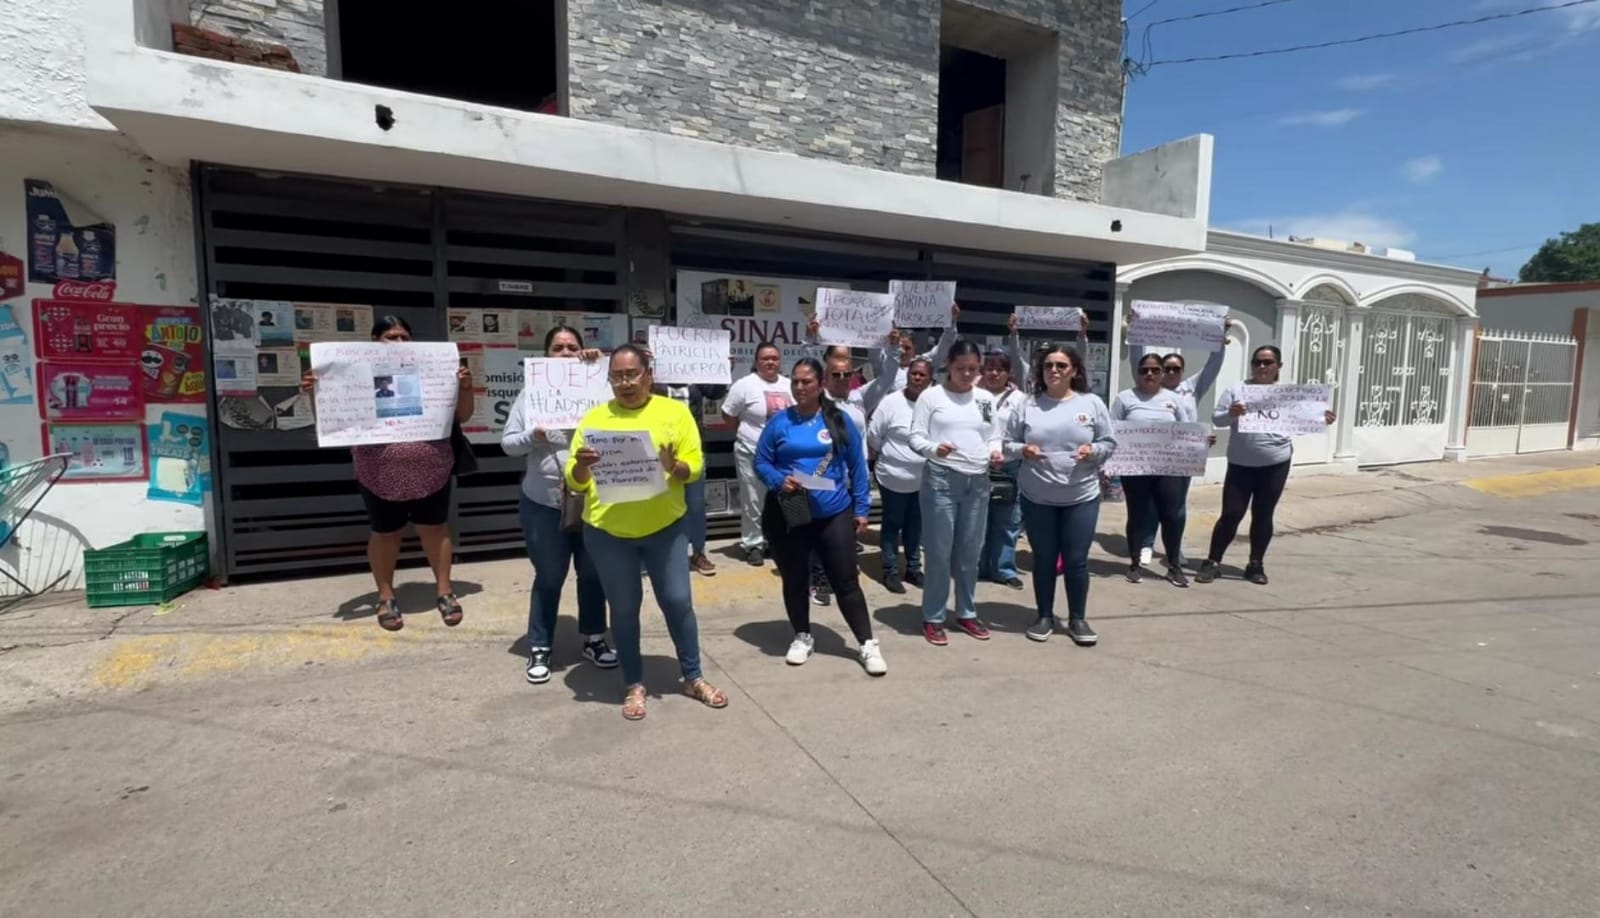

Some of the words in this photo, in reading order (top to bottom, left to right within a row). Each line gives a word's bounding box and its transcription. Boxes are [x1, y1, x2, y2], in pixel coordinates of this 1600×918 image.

[97, 314, 124, 323] Gran
[93, 323, 131, 332] precio
[720, 318, 802, 344] SINAL
[486, 371, 525, 383] omisió
[1257, 409, 1280, 420] NO
